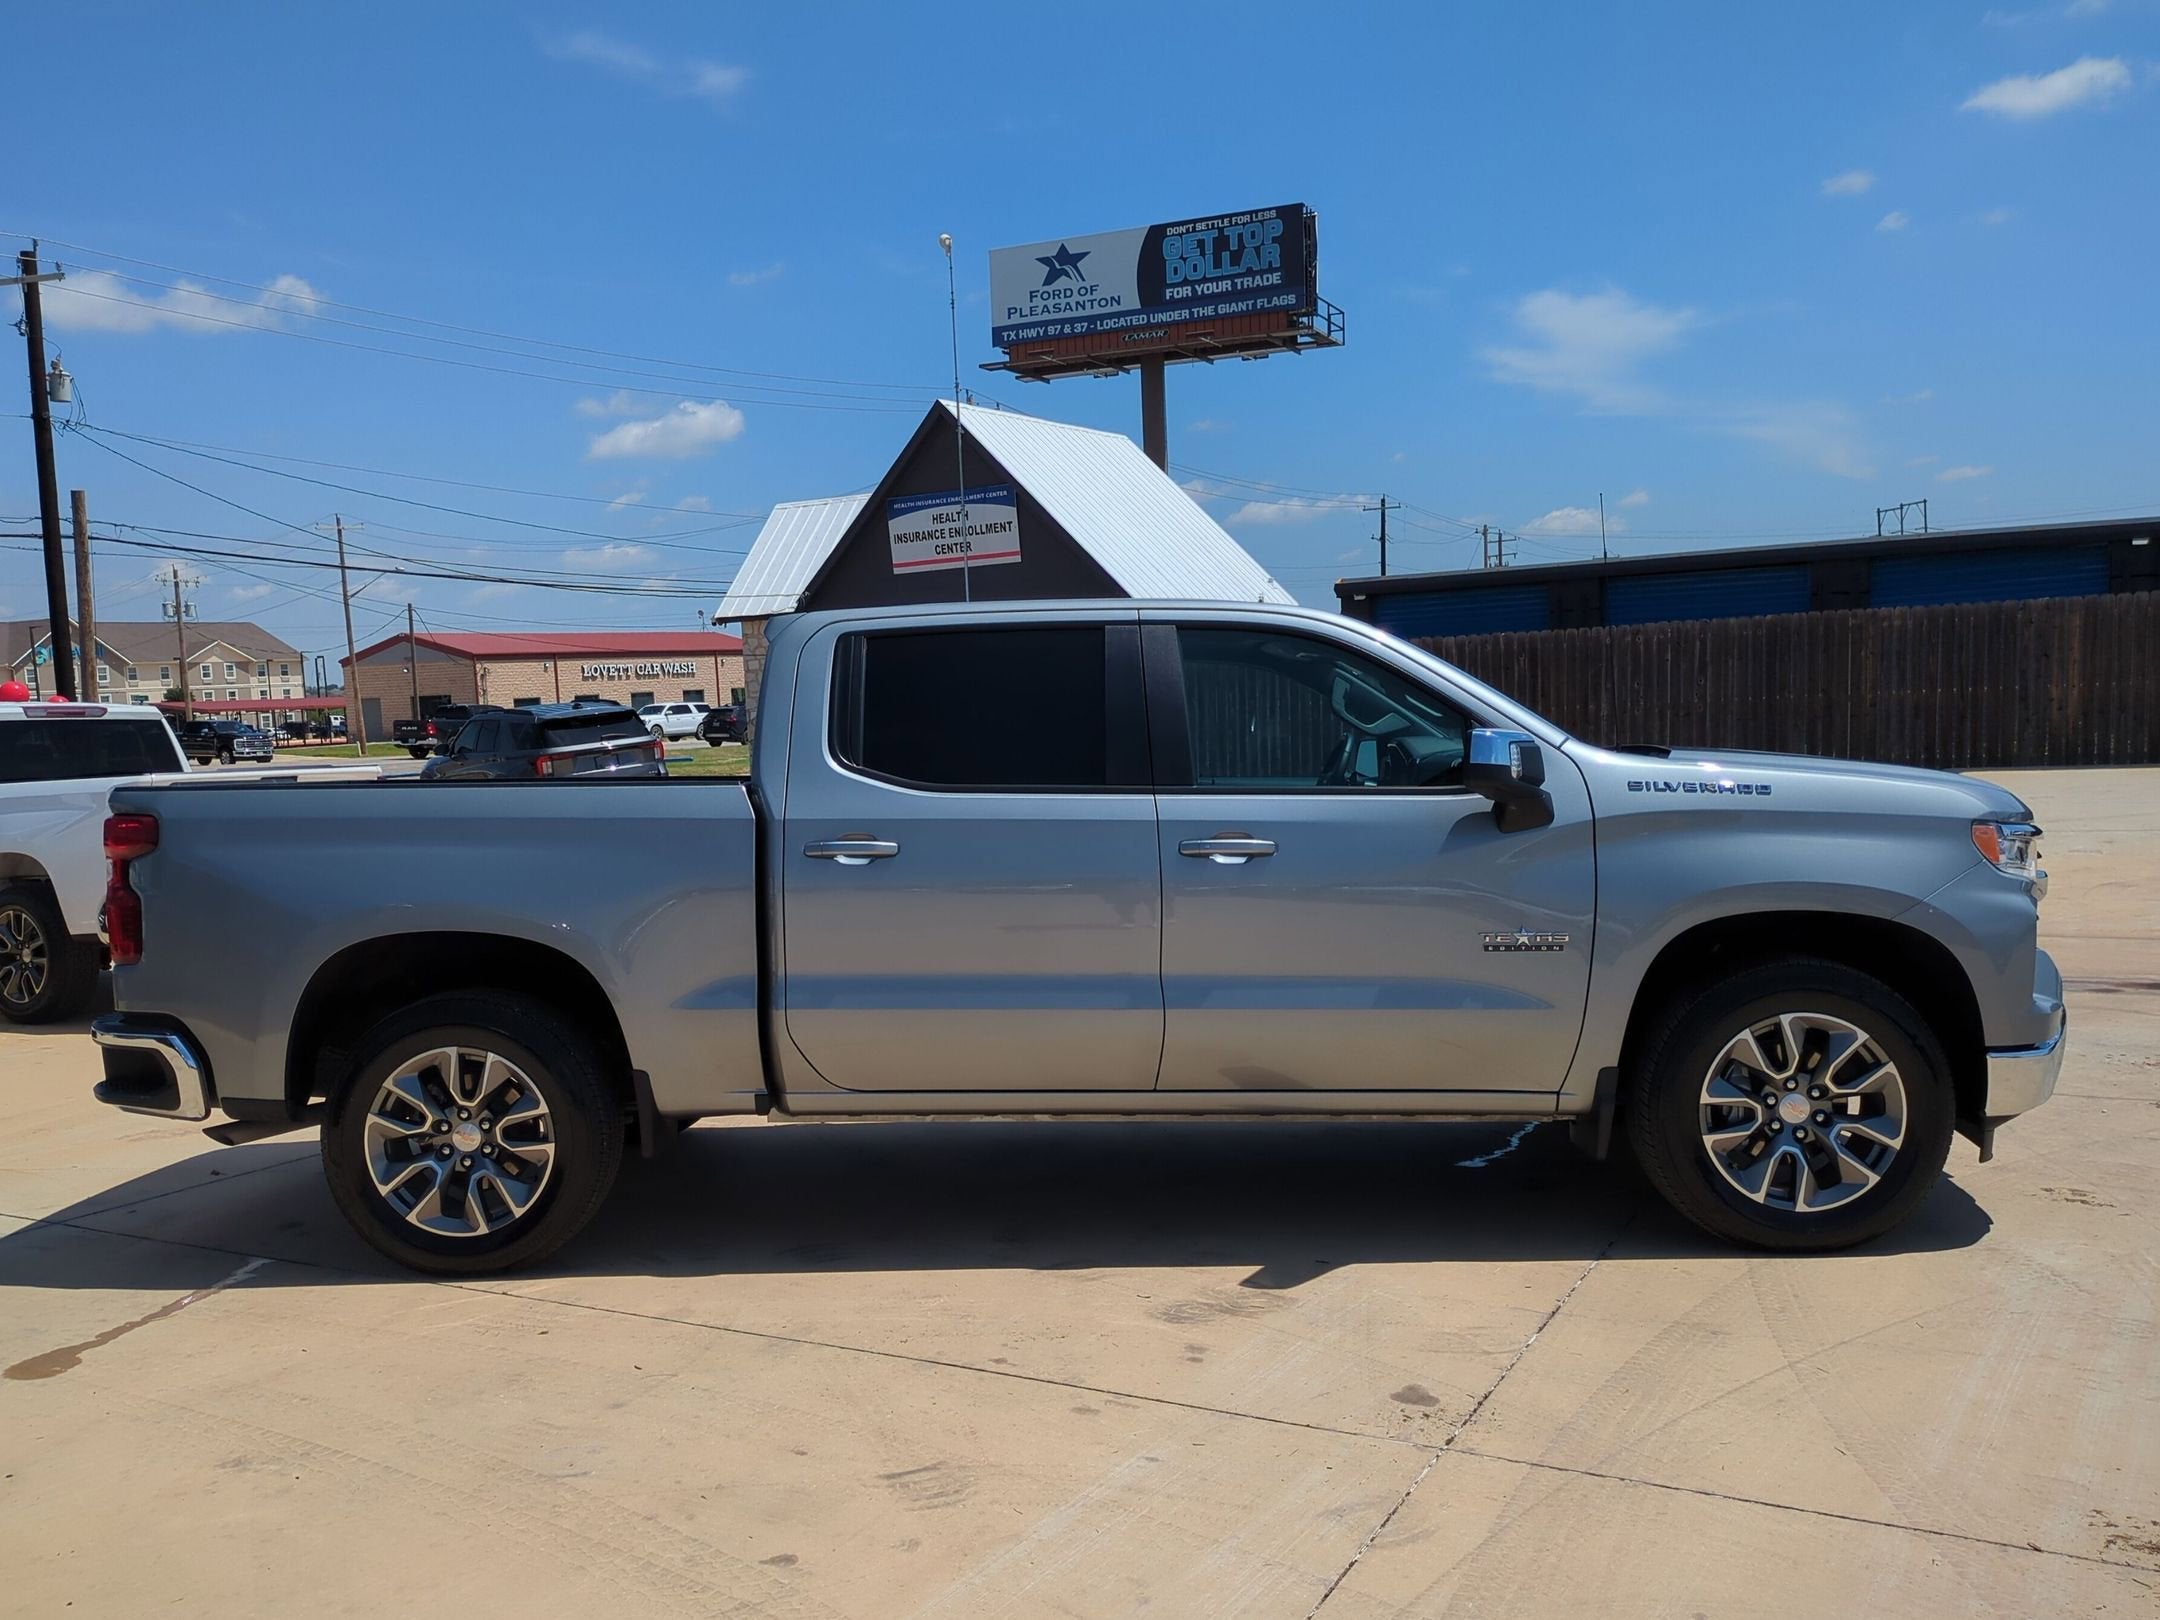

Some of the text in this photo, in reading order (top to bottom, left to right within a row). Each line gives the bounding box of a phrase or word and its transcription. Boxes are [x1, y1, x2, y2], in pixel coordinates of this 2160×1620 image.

[1167, 210, 1276, 235] DON'T SETTLE FOR LESS
[1163, 218, 1283, 260] GET TOP
[1166, 243, 1280, 284] DOLLAR
[1029, 284, 1099, 303] FORD OF
[1166, 272, 1282, 300] FOR YOUR TRADE
[1007, 295, 1121, 320] PLEASANTON
[1001, 331, 1017, 342] TX
[1019, 326, 1046, 340] HWY
[1048, 325, 1061, 336] 97
[1063, 323, 1072, 334] &
[1074, 322, 1088, 333] 37
[1097, 314, 1148, 330] LOCATED
[1150, 308, 1190, 323] UNDER
[1192, 305, 1215, 318] THE
[1218, 300, 1254, 314] GIANT
[1257, 294, 1296, 309] FLAGS
[1124, 330, 1165, 341] LAMAR
[893, 501, 915, 509] HEALTH
[915, 497, 947, 507] INSURANCE
[985, 490, 1008, 498] CENTER
[932, 510, 969, 525] HEALTH
[893, 528, 946, 545] INSURANCE
[934, 541, 973, 555] CENTER
[583, 662, 697, 677] LOVETT CAR WASH
[1627, 780, 1772, 795] SILVERADO
